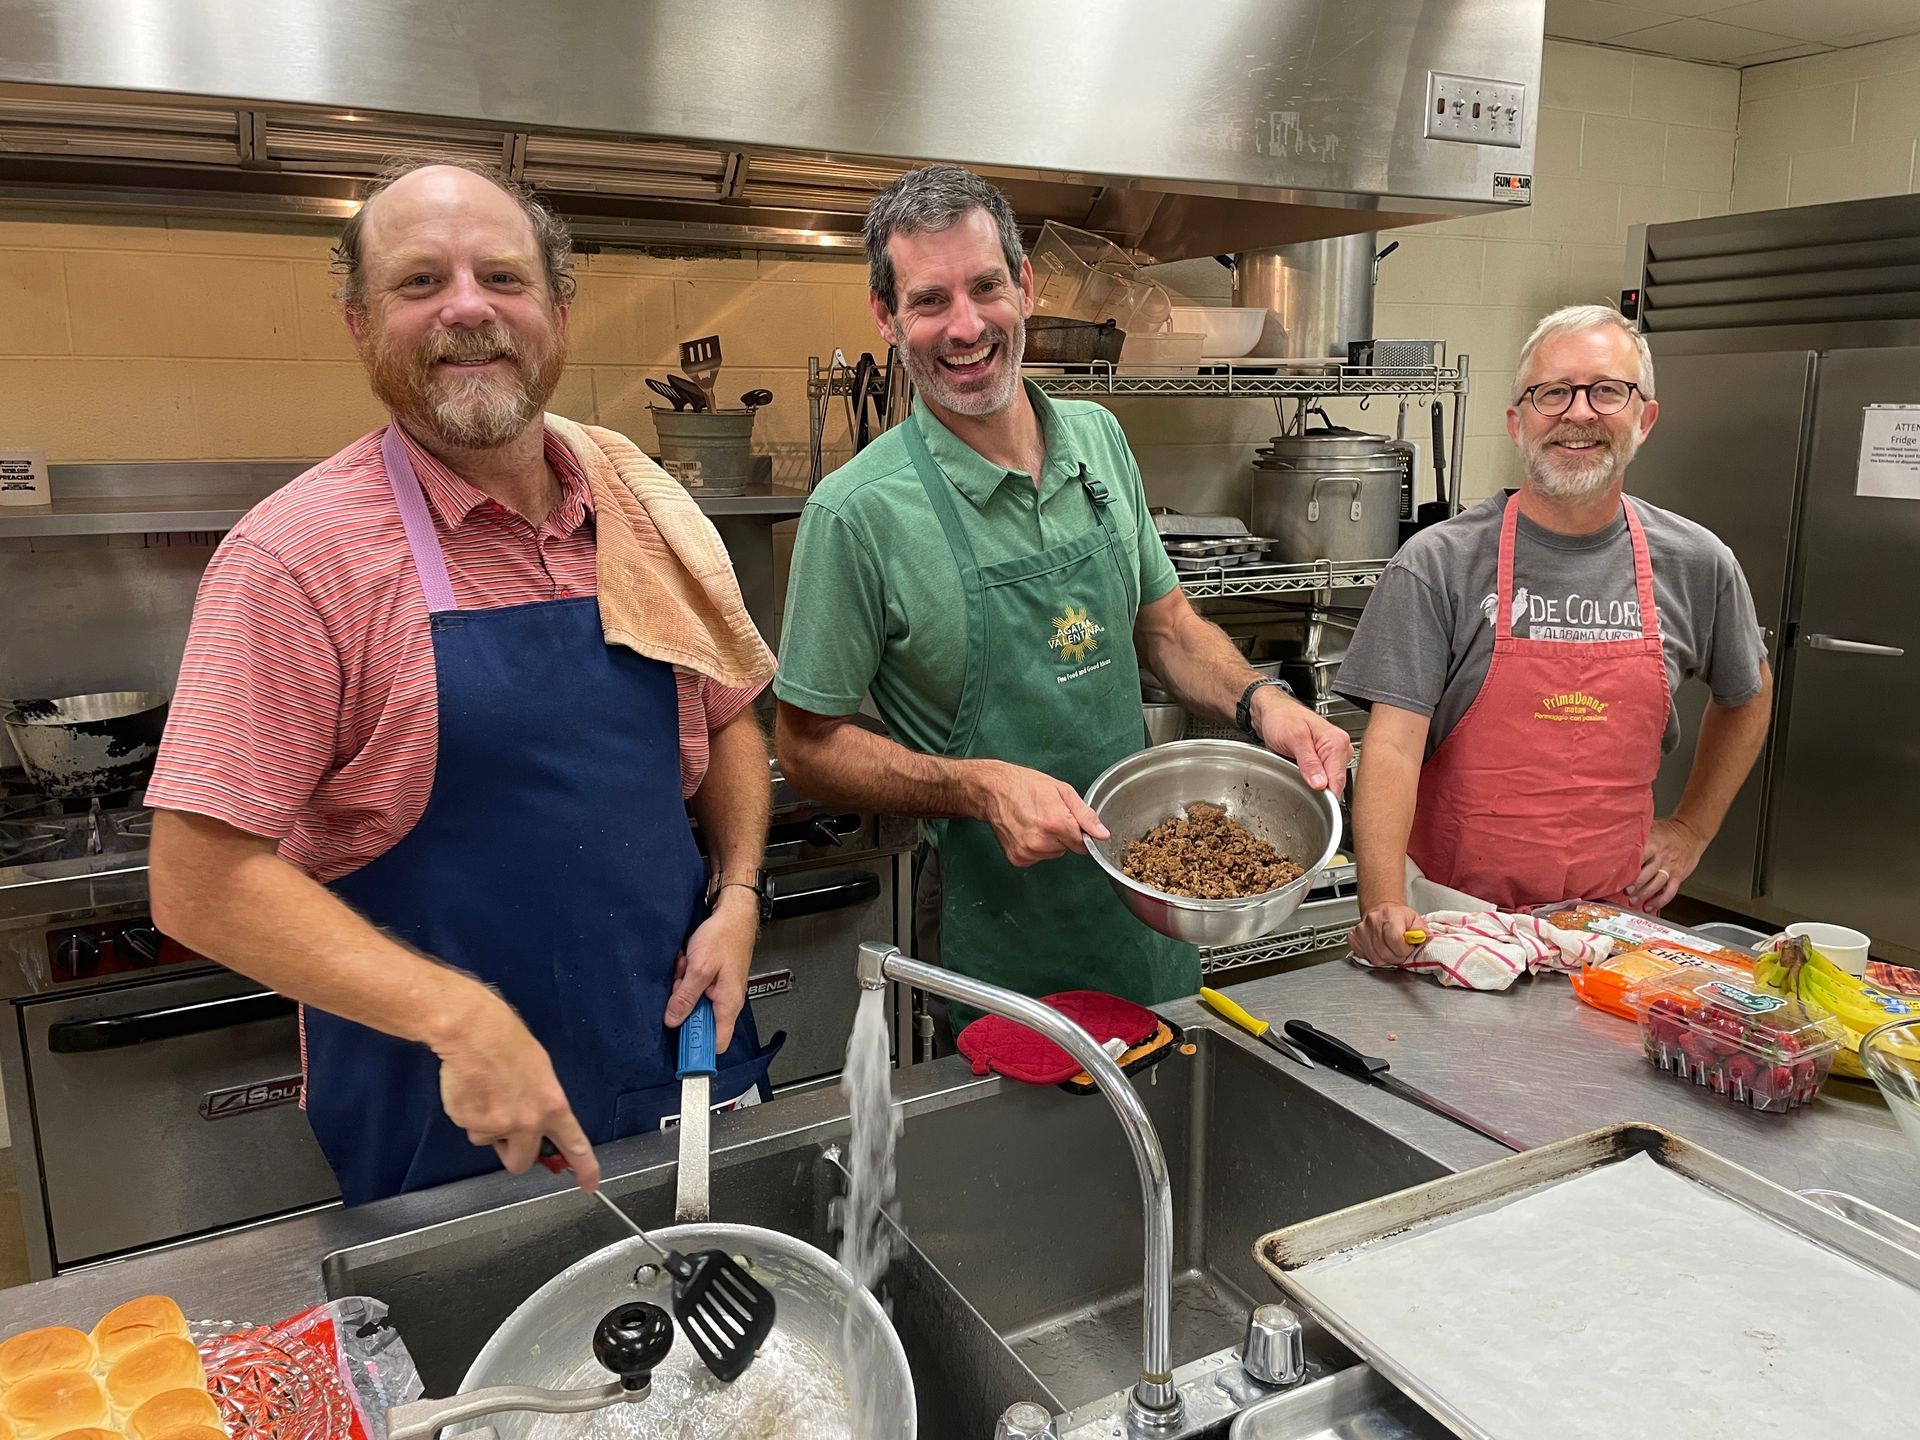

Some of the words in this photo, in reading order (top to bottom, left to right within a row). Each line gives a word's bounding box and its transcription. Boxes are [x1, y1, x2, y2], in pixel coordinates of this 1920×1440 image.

[1891, 435, 1917, 447] Fridge
[1529, 595, 1561, 623] DE
[1543, 627, 1595, 641] ALABAMA
[1067, 670, 1079, 681] Food
[1087, 662, 1099, 672] Good
